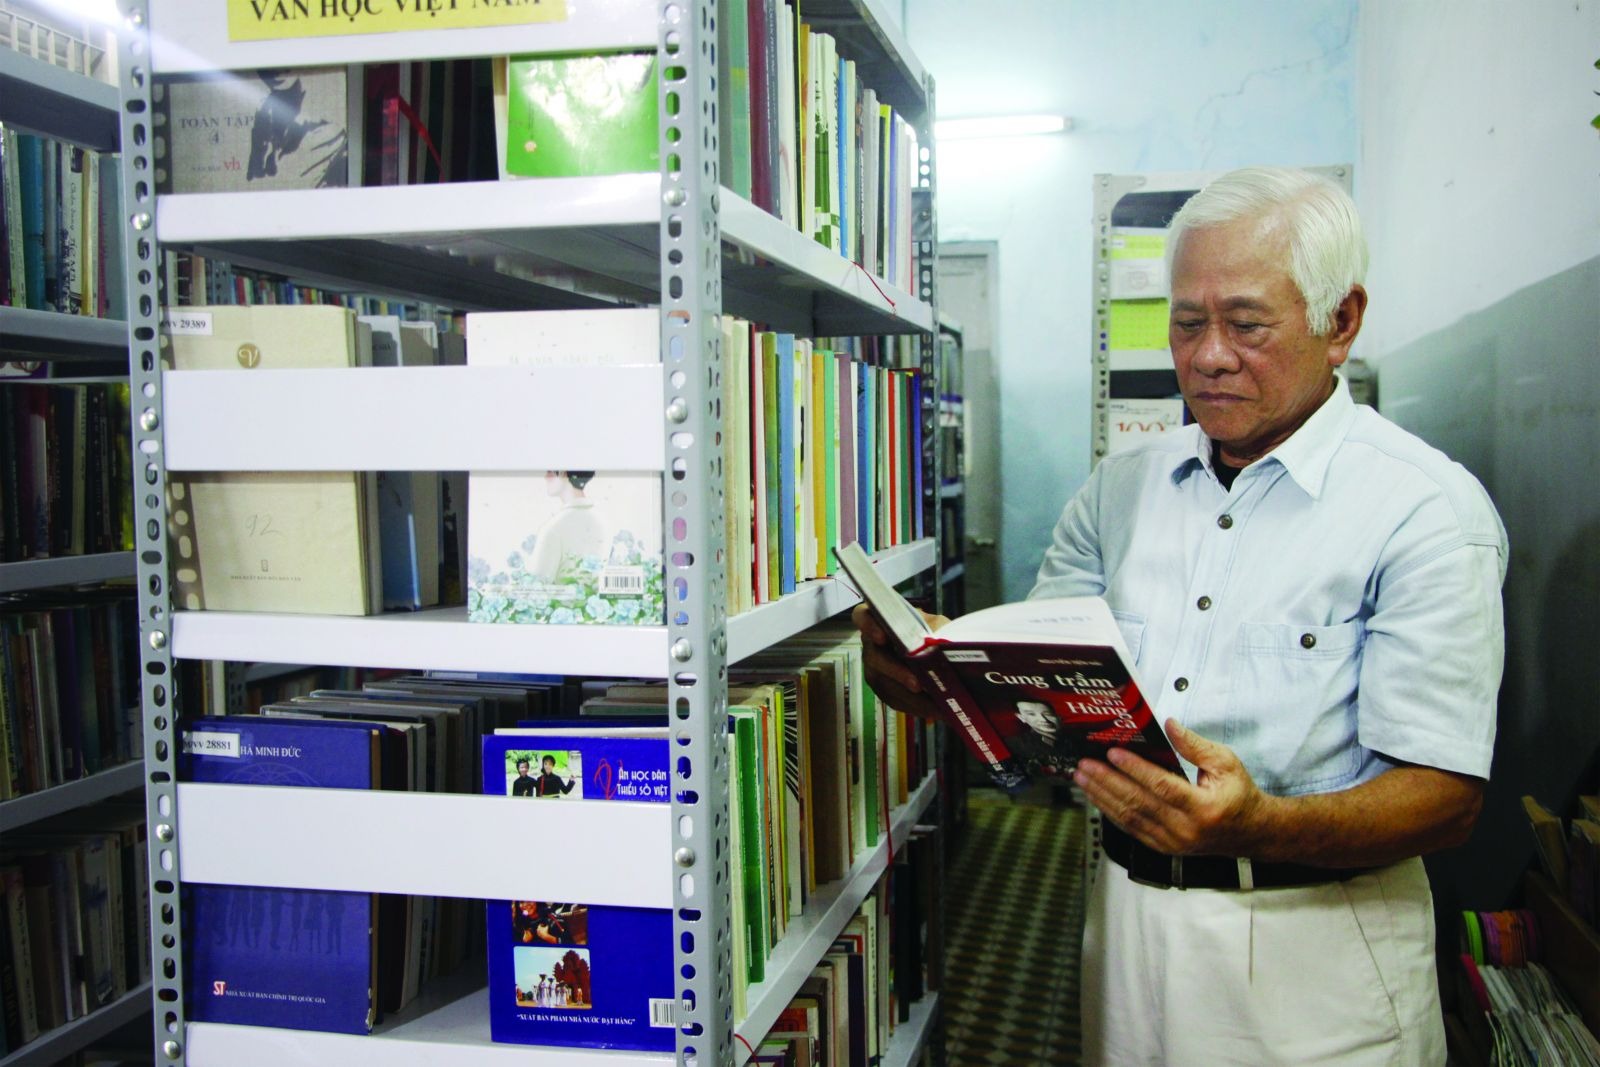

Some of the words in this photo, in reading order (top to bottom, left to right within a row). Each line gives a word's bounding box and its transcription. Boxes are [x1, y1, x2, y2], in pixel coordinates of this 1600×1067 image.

[180, 319, 207, 329] 29389
[984, 671, 1050, 689] Cung
[1054, 671, 1115, 689] trầm
[1072, 686, 1122, 699] trong
[1064, 701, 1133, 720] Hùng
[206, 739, 231, 750] 28881
[255, 746, 280, 757] MINH
[281, 745, 302, 758] ĐỨC
[631, 770, 650, 782] HỌC
[651, 768, 667, 781] DÂN
[653, 783, 668, 798] VIỆT
[213, 981, 226, 996] ST
